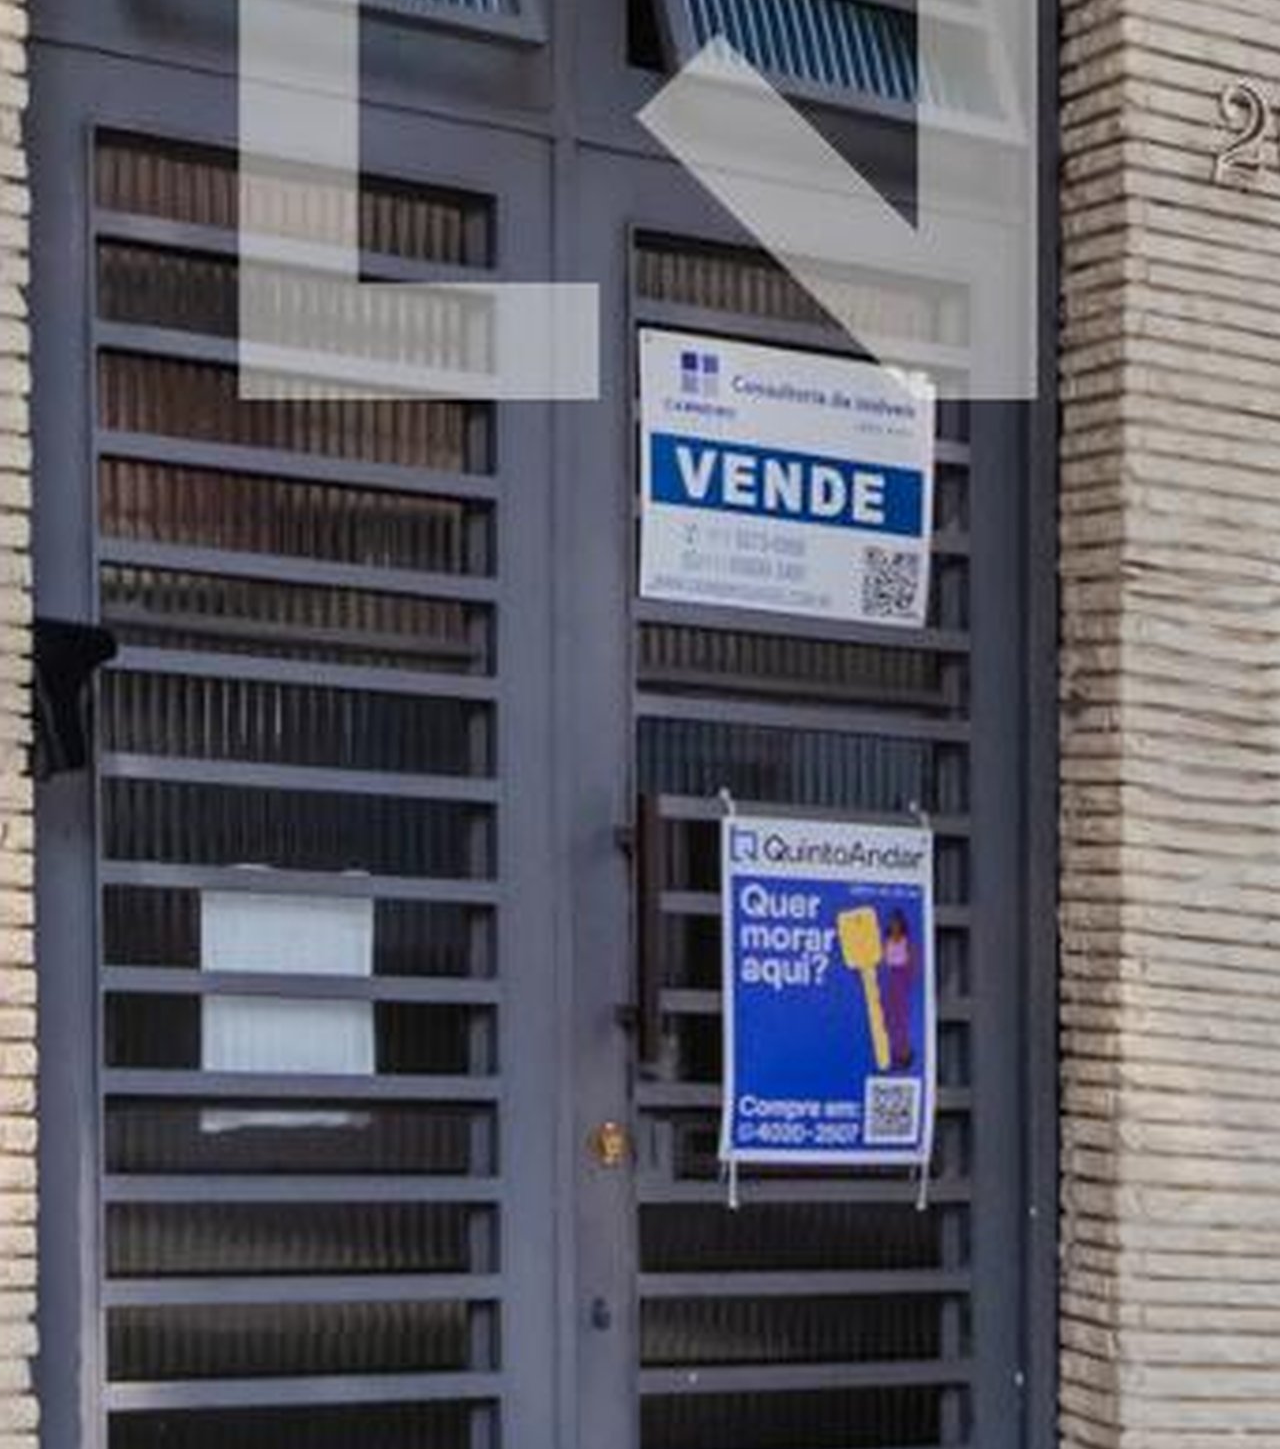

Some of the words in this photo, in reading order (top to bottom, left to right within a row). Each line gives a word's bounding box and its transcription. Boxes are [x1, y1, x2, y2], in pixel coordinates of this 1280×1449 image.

[676, 447, 885, 524] VENDE
[764, 833, 924, 868] QuintoAndar
[740, 883, 820, 918] Quer
[740, 924, 835, 951] morar
[741, 952, 829, 990] aqui?
[739, 1095, 820, 1119] Compre
